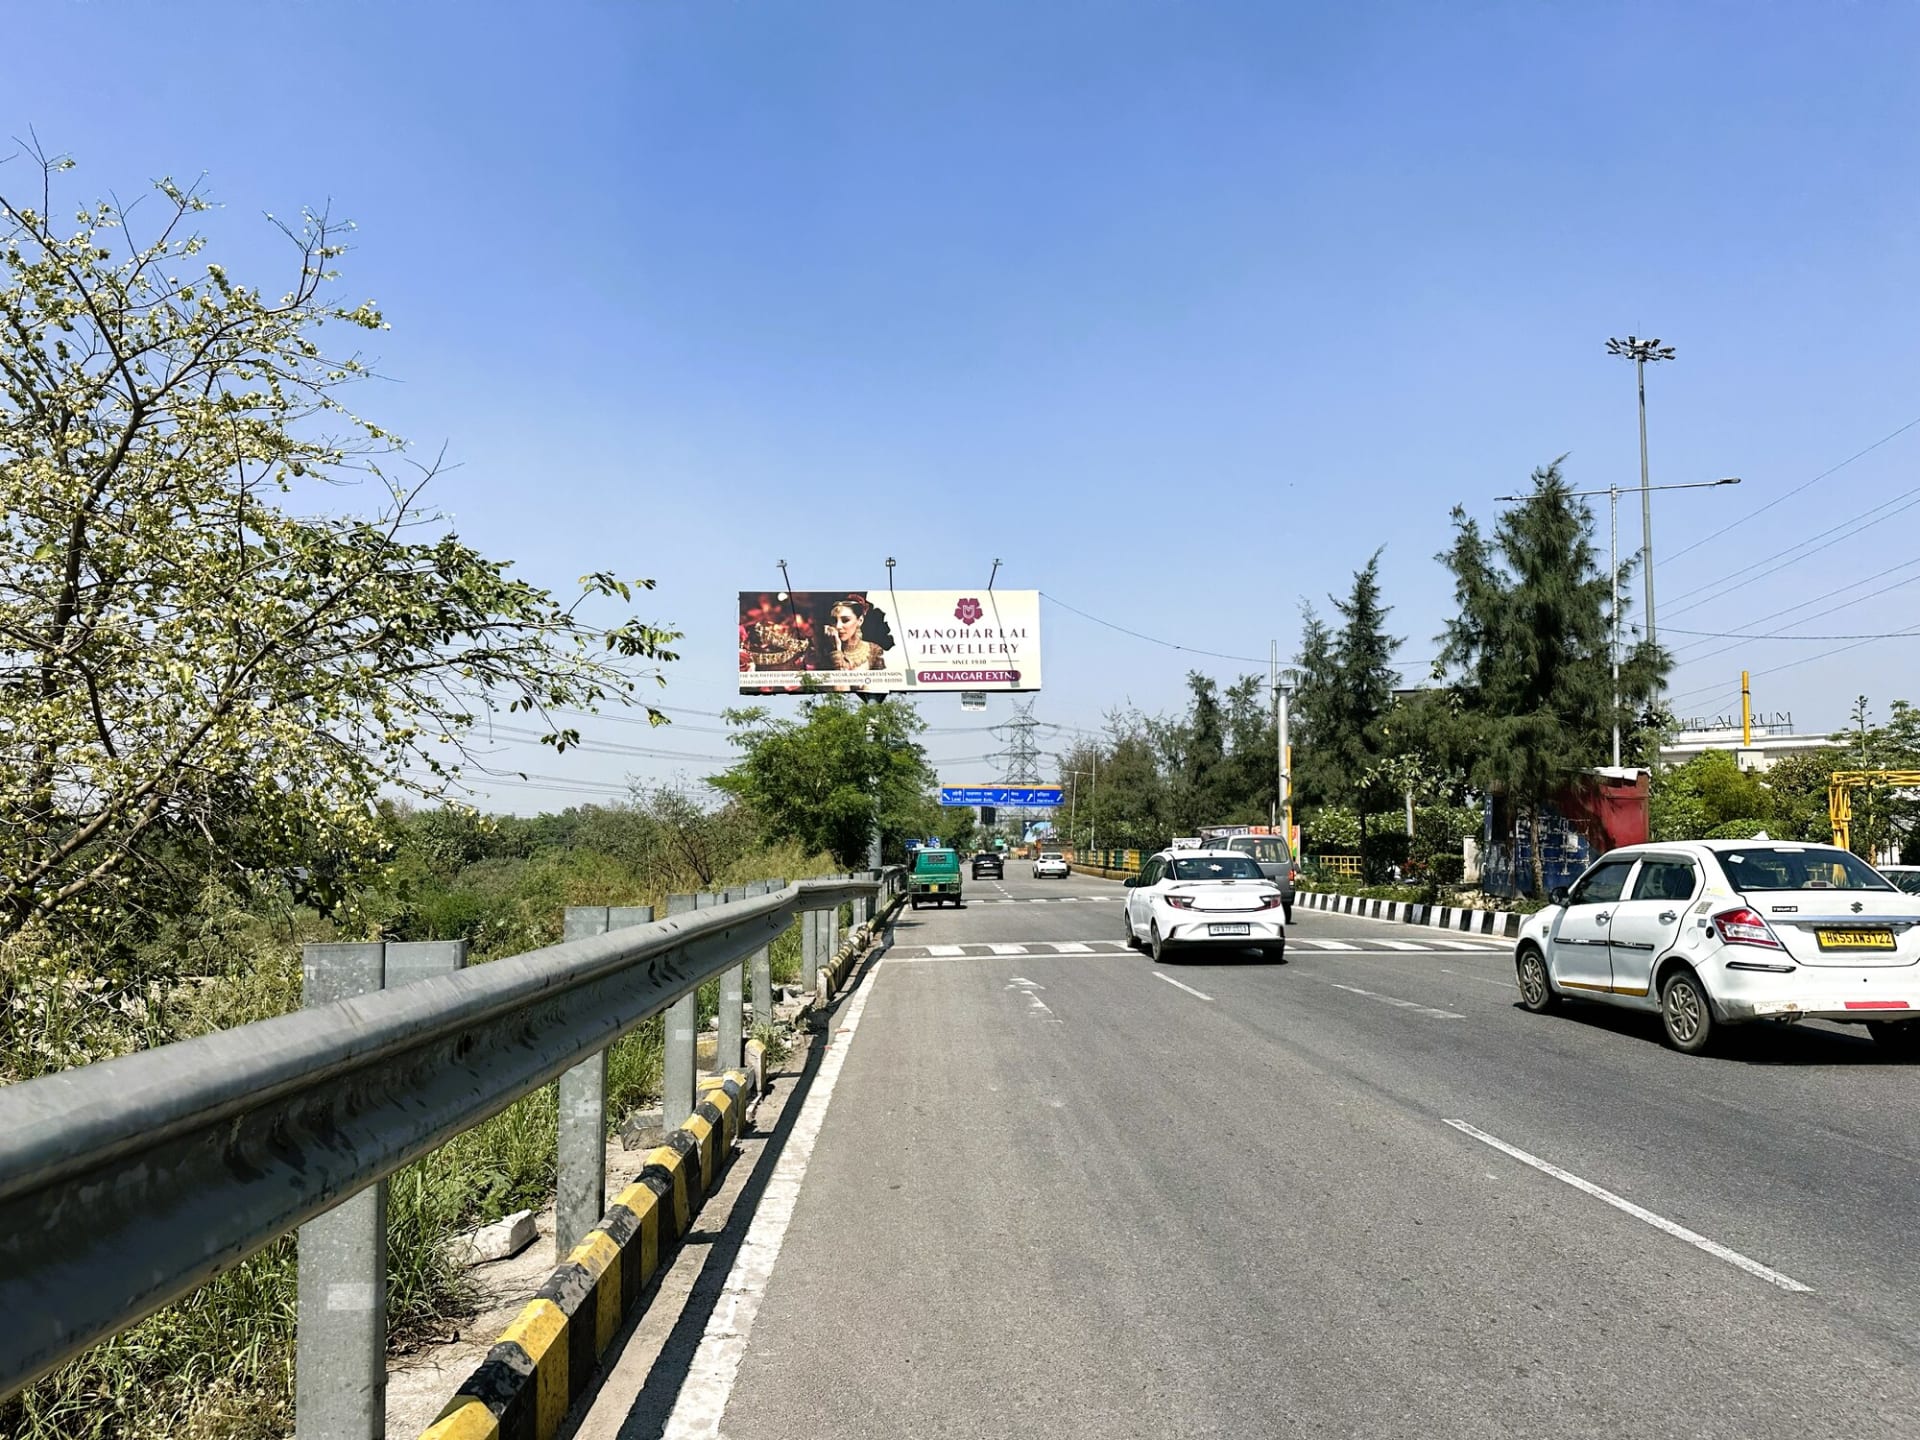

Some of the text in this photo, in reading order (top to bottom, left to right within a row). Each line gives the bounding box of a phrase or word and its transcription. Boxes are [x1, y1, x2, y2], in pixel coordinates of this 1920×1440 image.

[907, 628, 1029, 639] MANOHAR LAL
[920, 643, 1019, 654] JEWELLERY
[923, 671, 1016, 681] RAJ NAGAR EXTN.
